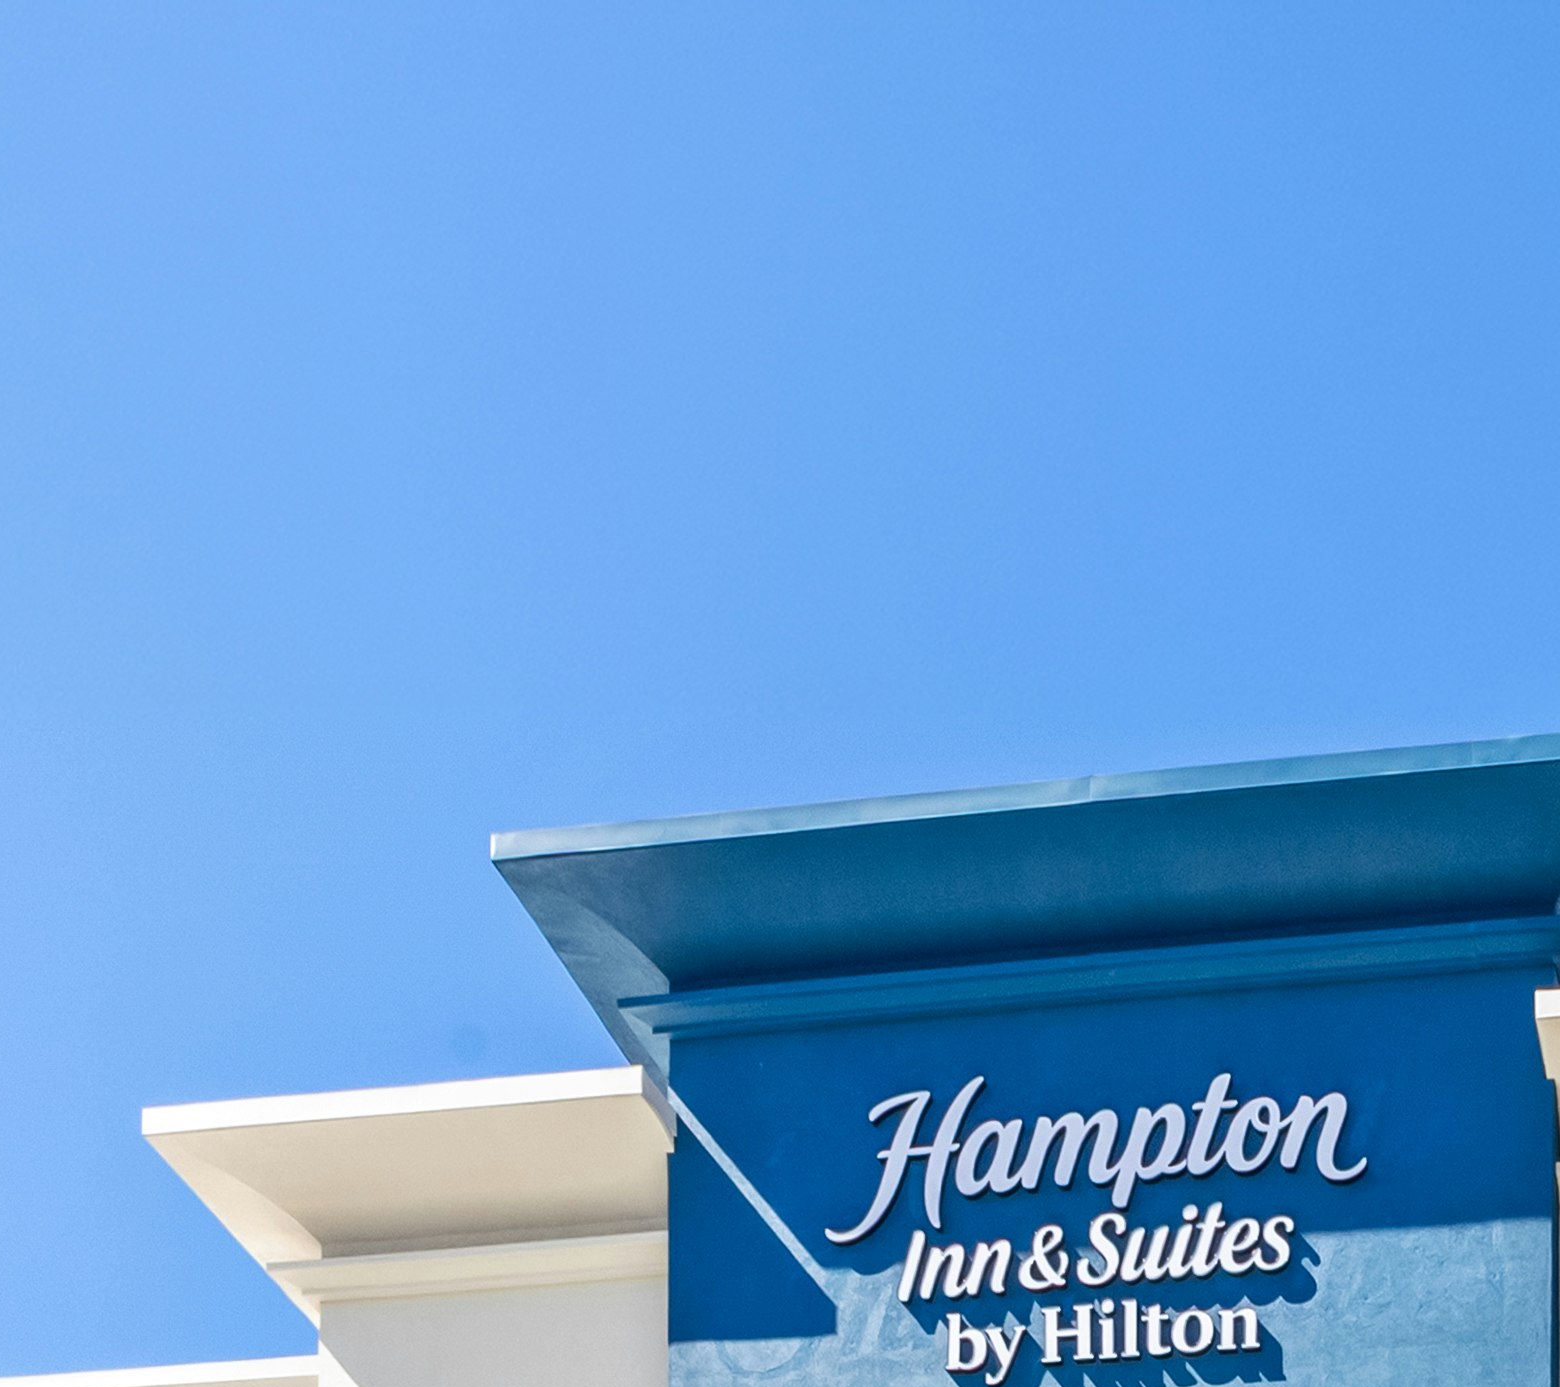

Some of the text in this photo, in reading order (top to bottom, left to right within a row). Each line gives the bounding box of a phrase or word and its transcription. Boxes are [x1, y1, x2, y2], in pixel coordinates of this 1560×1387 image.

[825, 1072, 1368, 1245] Hampton
[897, 1201, 1295, 1302] Inn & Suites
[945, 1298, 1260, 1386] by Hilton
